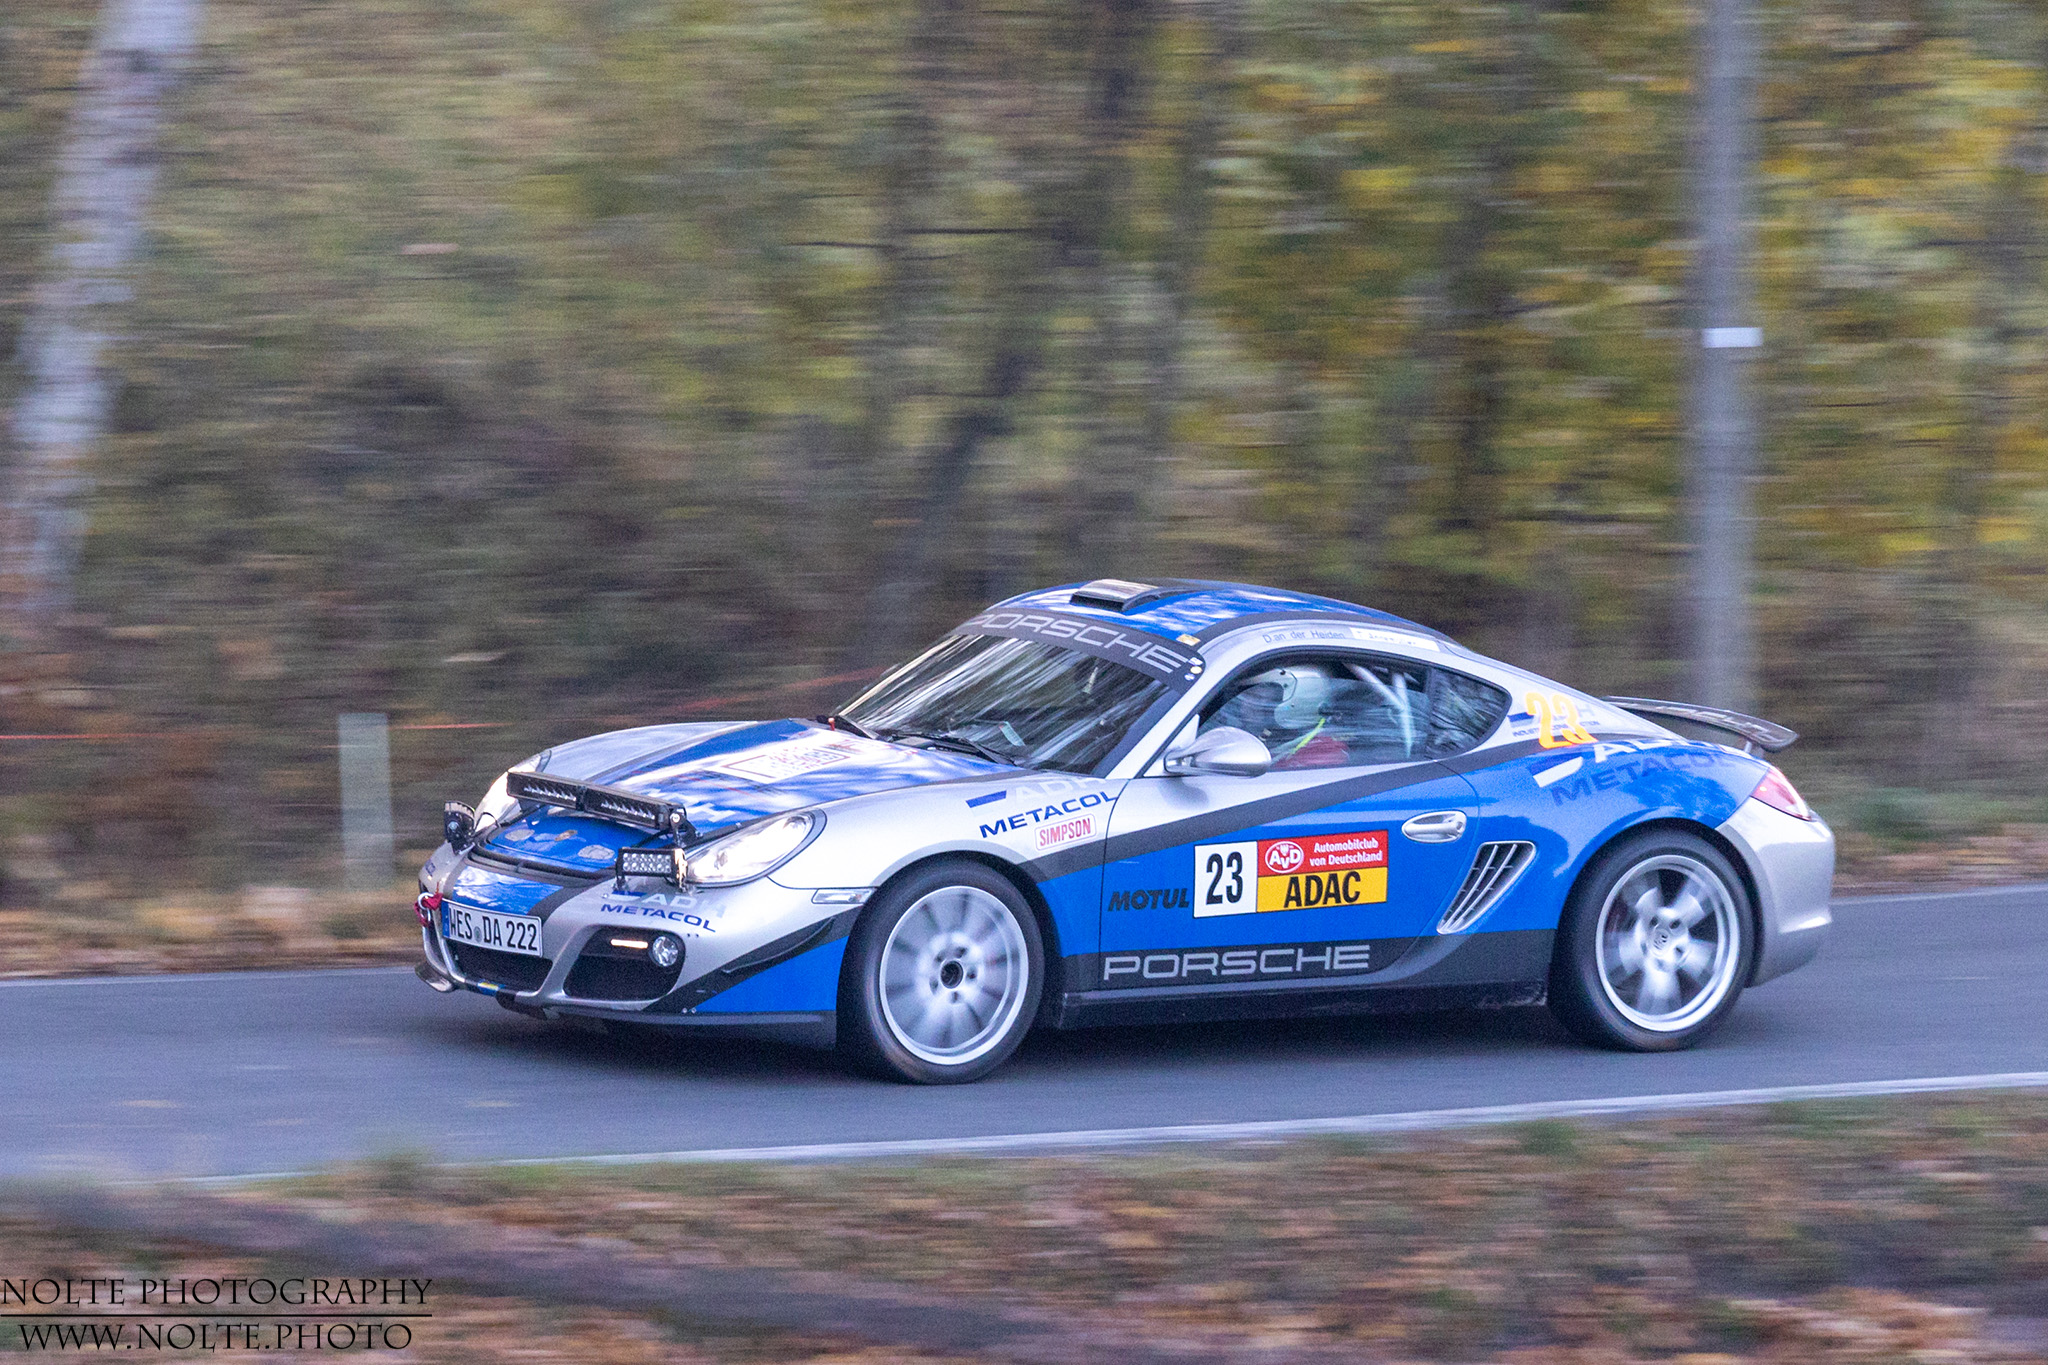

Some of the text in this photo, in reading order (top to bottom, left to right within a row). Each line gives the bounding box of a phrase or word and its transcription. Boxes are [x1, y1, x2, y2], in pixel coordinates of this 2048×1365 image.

[957, 613, 1190, 674] PORSCHE
[1290, 630, 1305, 639] der
[1310, 630, 1346, 640] Heiden
[1525, 691, 1599, 749] 23
[979, 791, 1118, 838] METACOL
[1039, 817, 1092, 846] SIMPSON
[1309, 850, 1383, 867] von Deutschland
[1313, 837, 1379, 853] Automobilclub
[1205, 851, 1244, 905] 23
[1283, 870, 1361, 909] ADAC
[600, 903, 716, 933] METACOL
[1107, 888, 1190, 912] MOTUL
[482, 915, 502, 946] DA
[506, 920, 538, 952] 222
[1103, 944, 1371, 981] PORSCHE
